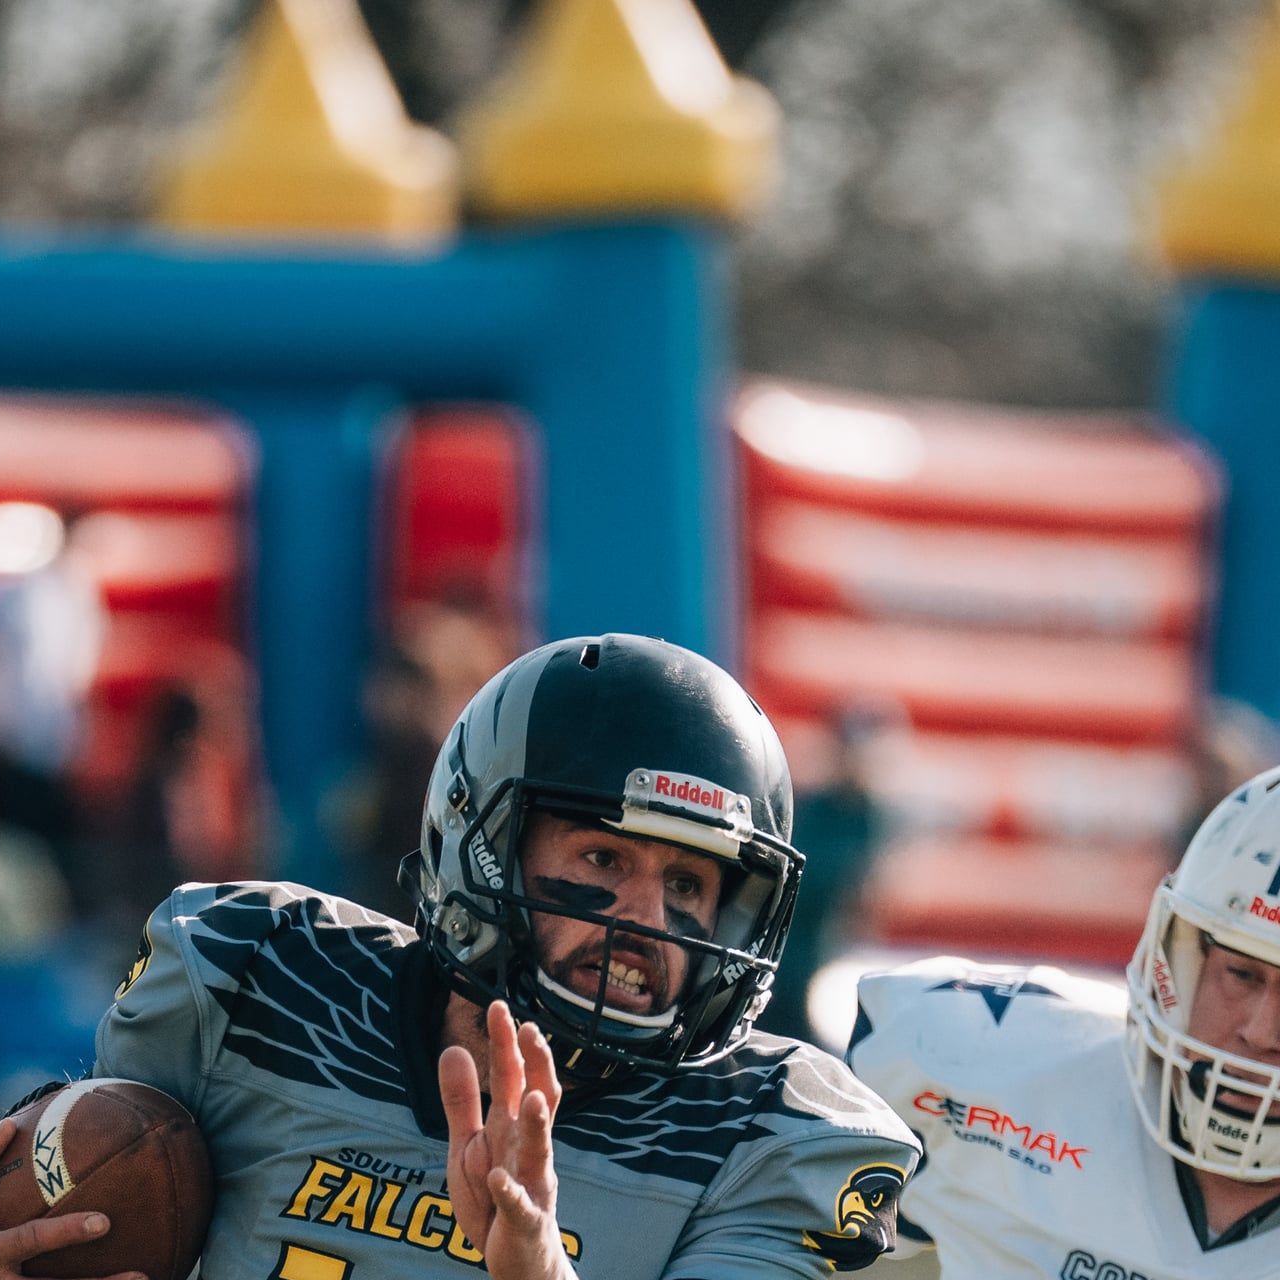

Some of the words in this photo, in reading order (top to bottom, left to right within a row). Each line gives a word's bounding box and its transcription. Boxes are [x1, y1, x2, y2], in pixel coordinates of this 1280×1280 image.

[655, 775, 724, 810] Riddell
[470, 829, 504, 890] Ridde
[1207, 1117, 1262, 1145] Riddel
[337, 1147, 426, 1186] SOUTH
[279, 1154, 583, 1272] FALC
